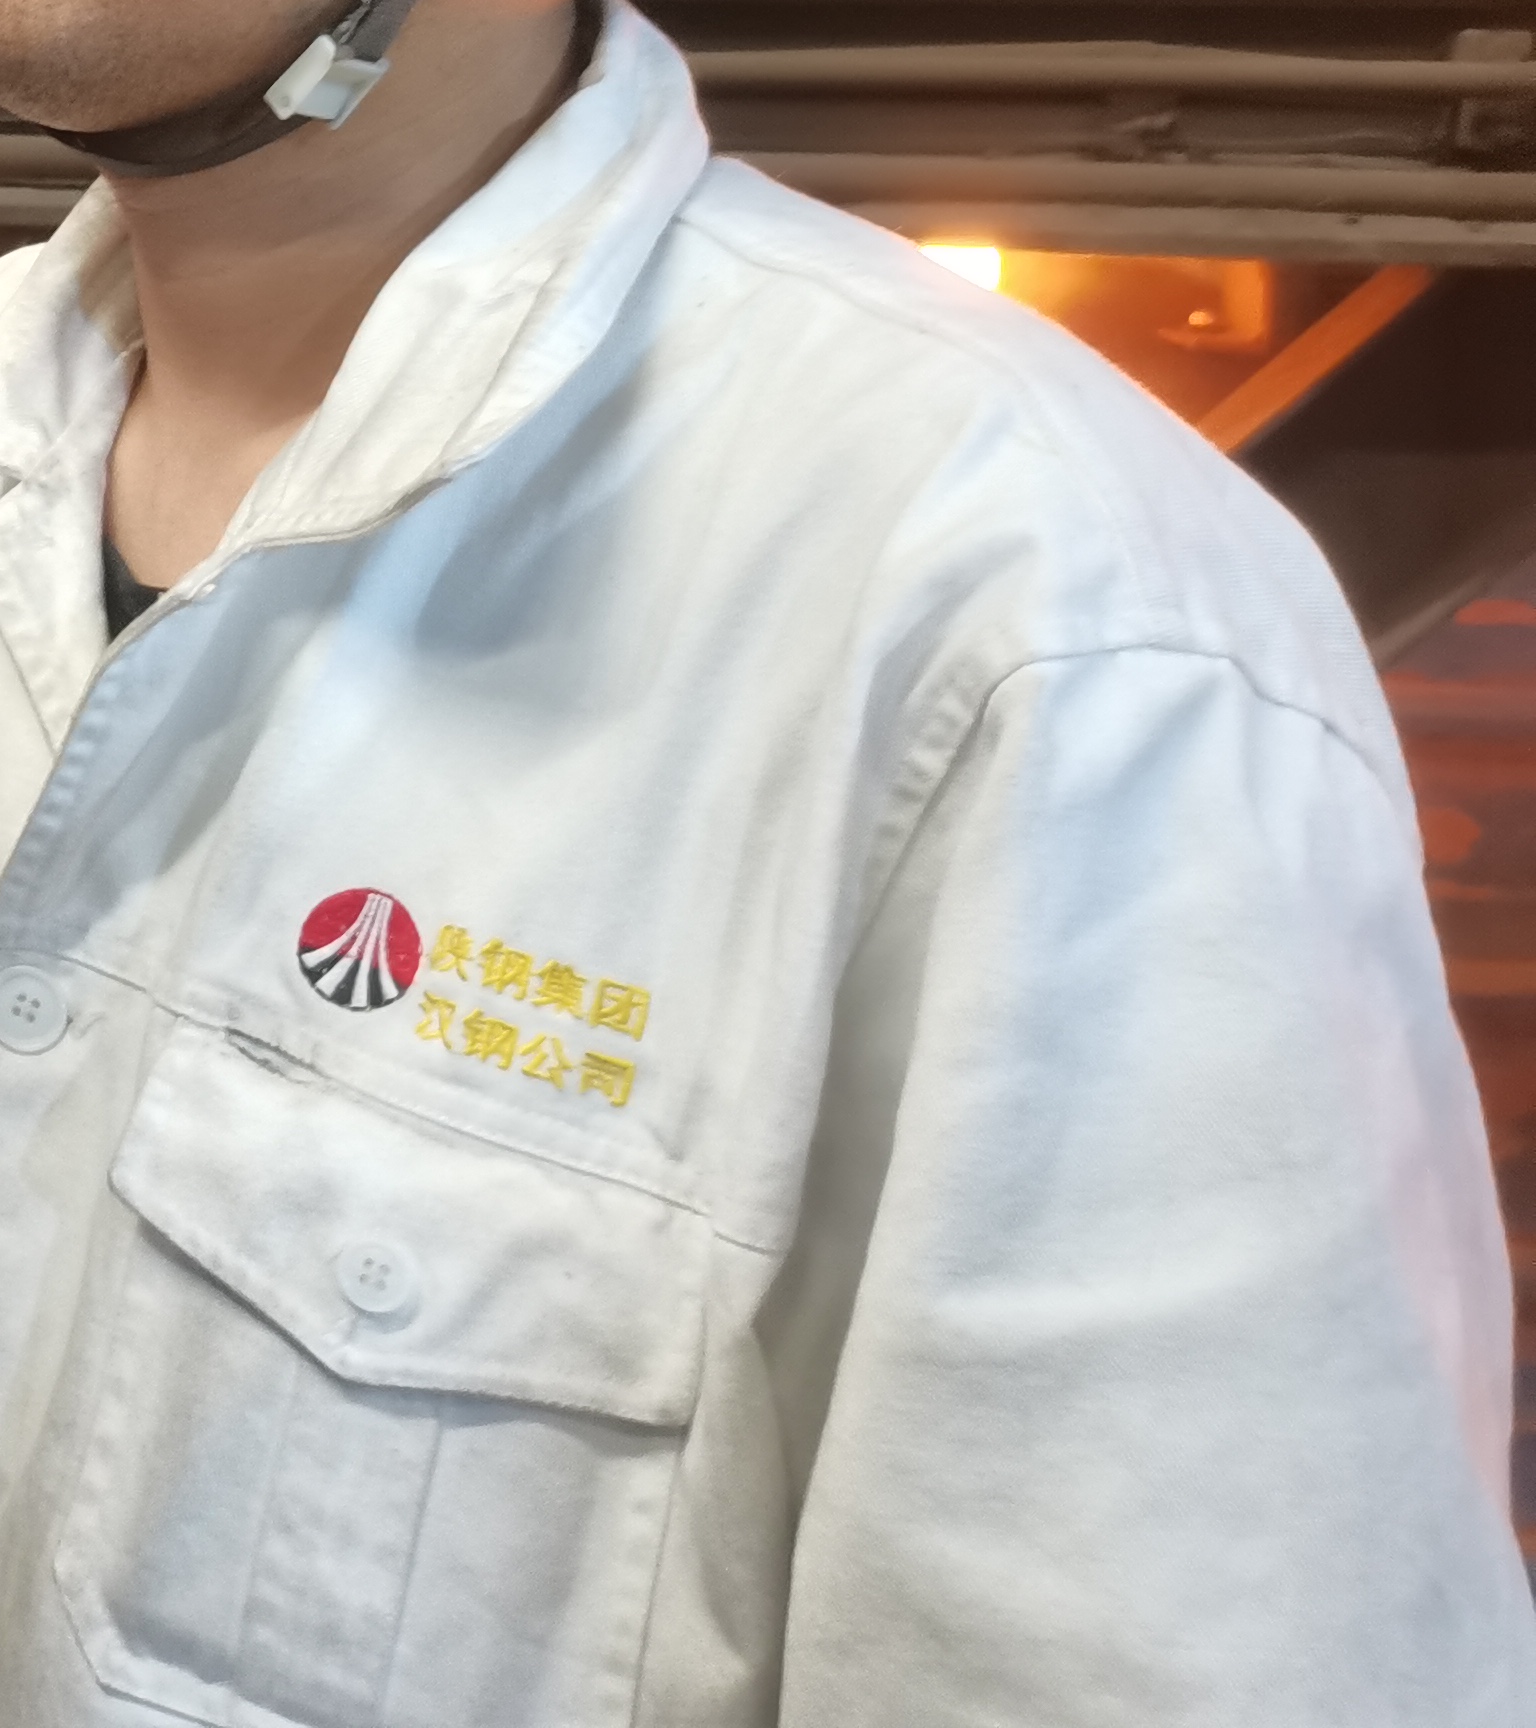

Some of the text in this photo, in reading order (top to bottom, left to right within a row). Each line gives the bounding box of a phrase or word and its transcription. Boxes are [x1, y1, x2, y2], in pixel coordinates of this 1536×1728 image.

[430, 924, 650, 1041] 陕钢集团
[415, 991, 636, 1107] 汉钢公司
